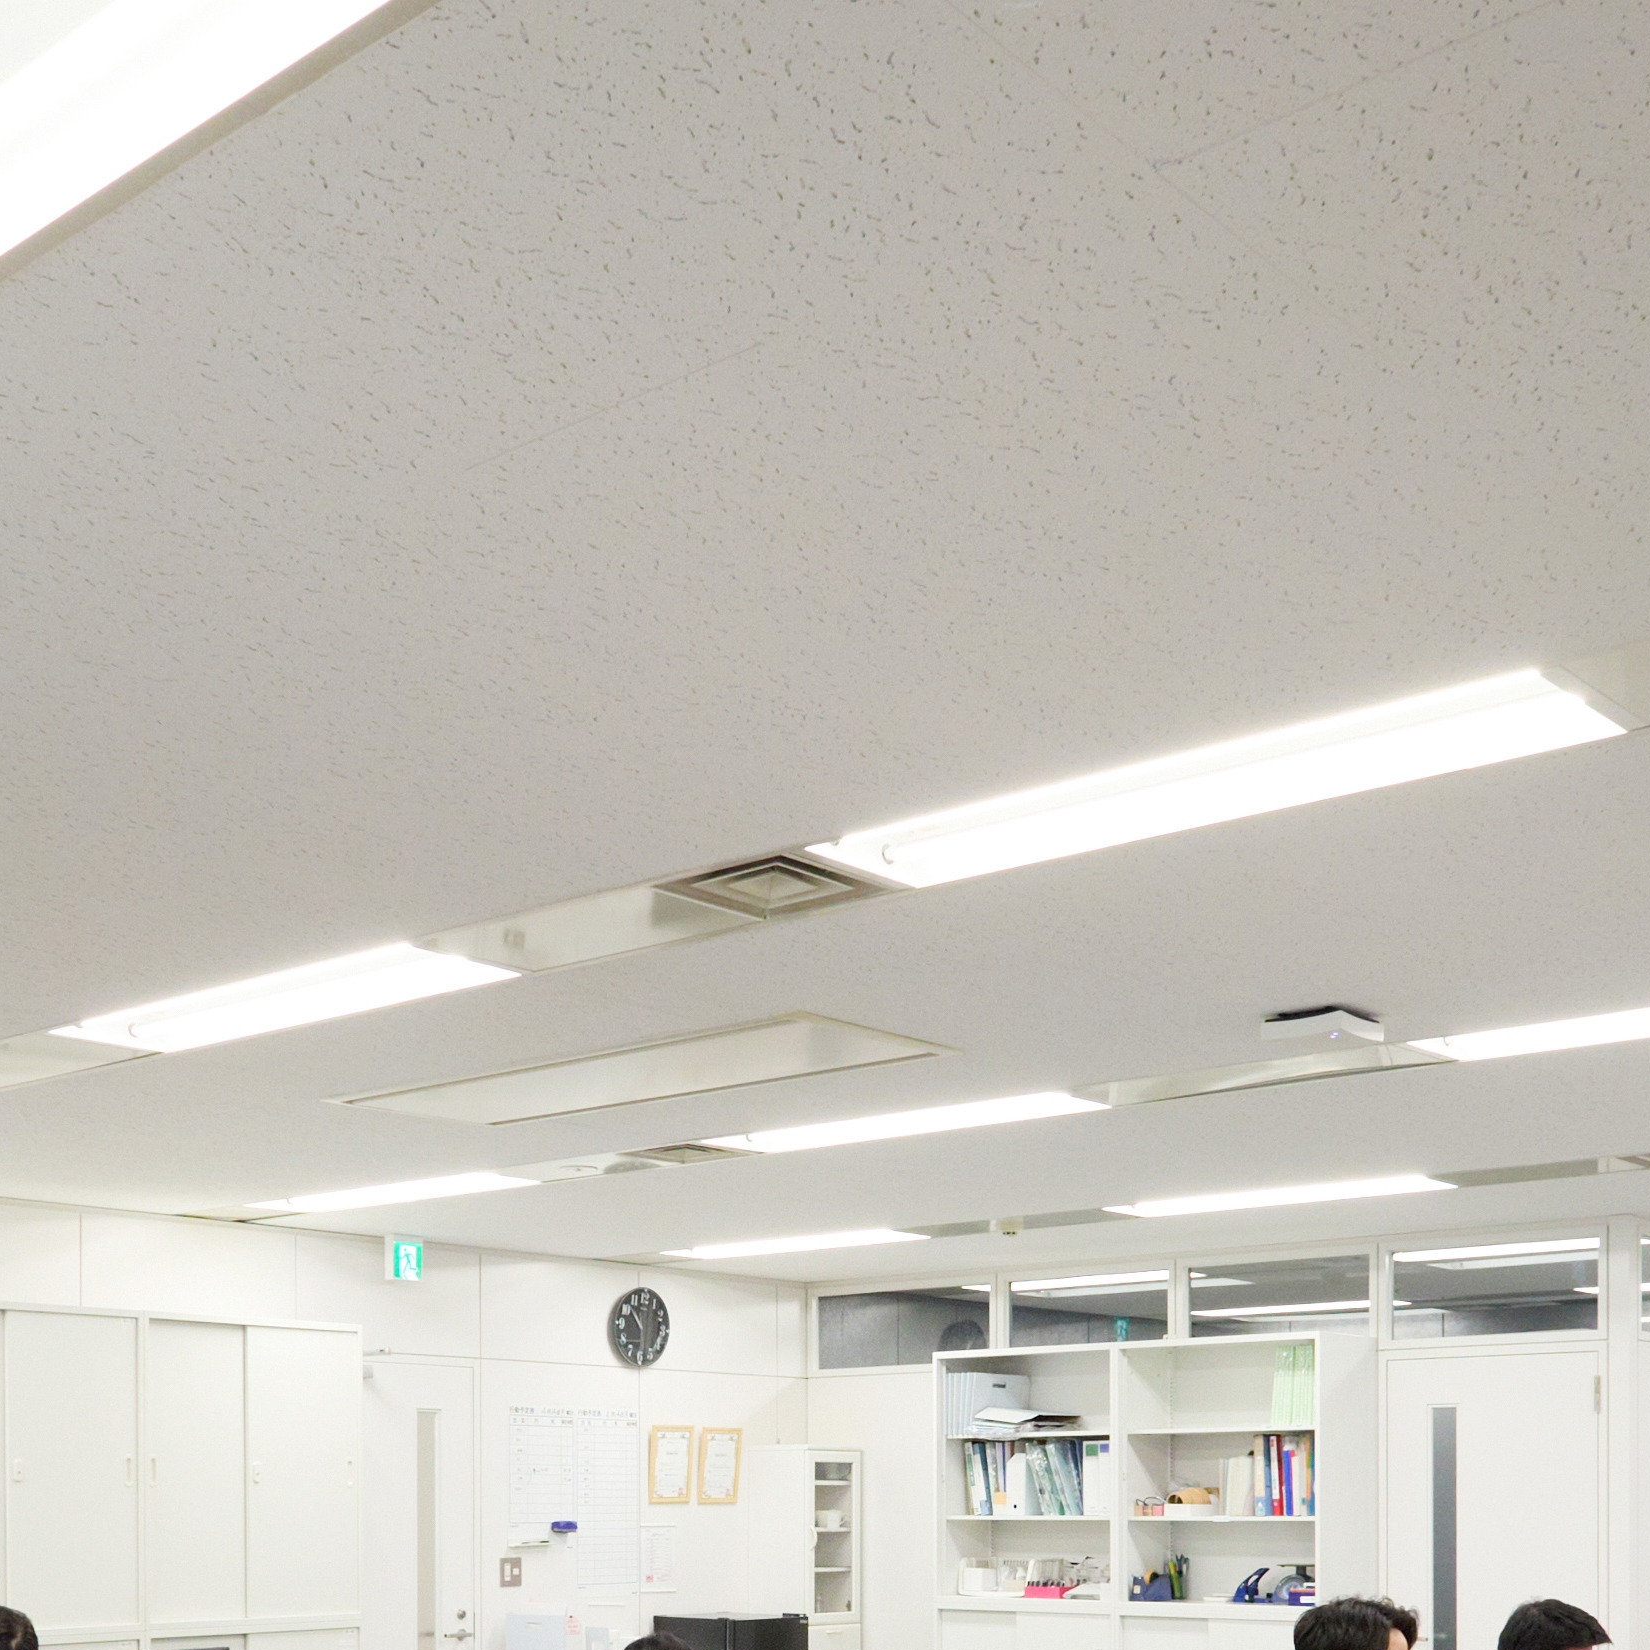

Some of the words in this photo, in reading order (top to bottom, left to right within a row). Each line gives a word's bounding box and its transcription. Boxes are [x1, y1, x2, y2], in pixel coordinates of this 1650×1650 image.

[630, 1294, 638, 1306] 11
[640, 1291, 650, 1304] 12
[621, 1303, 631, 1315] 10
[618, 1317, 625, 1330] 9
[619, 1332, 627, 1345] 8
